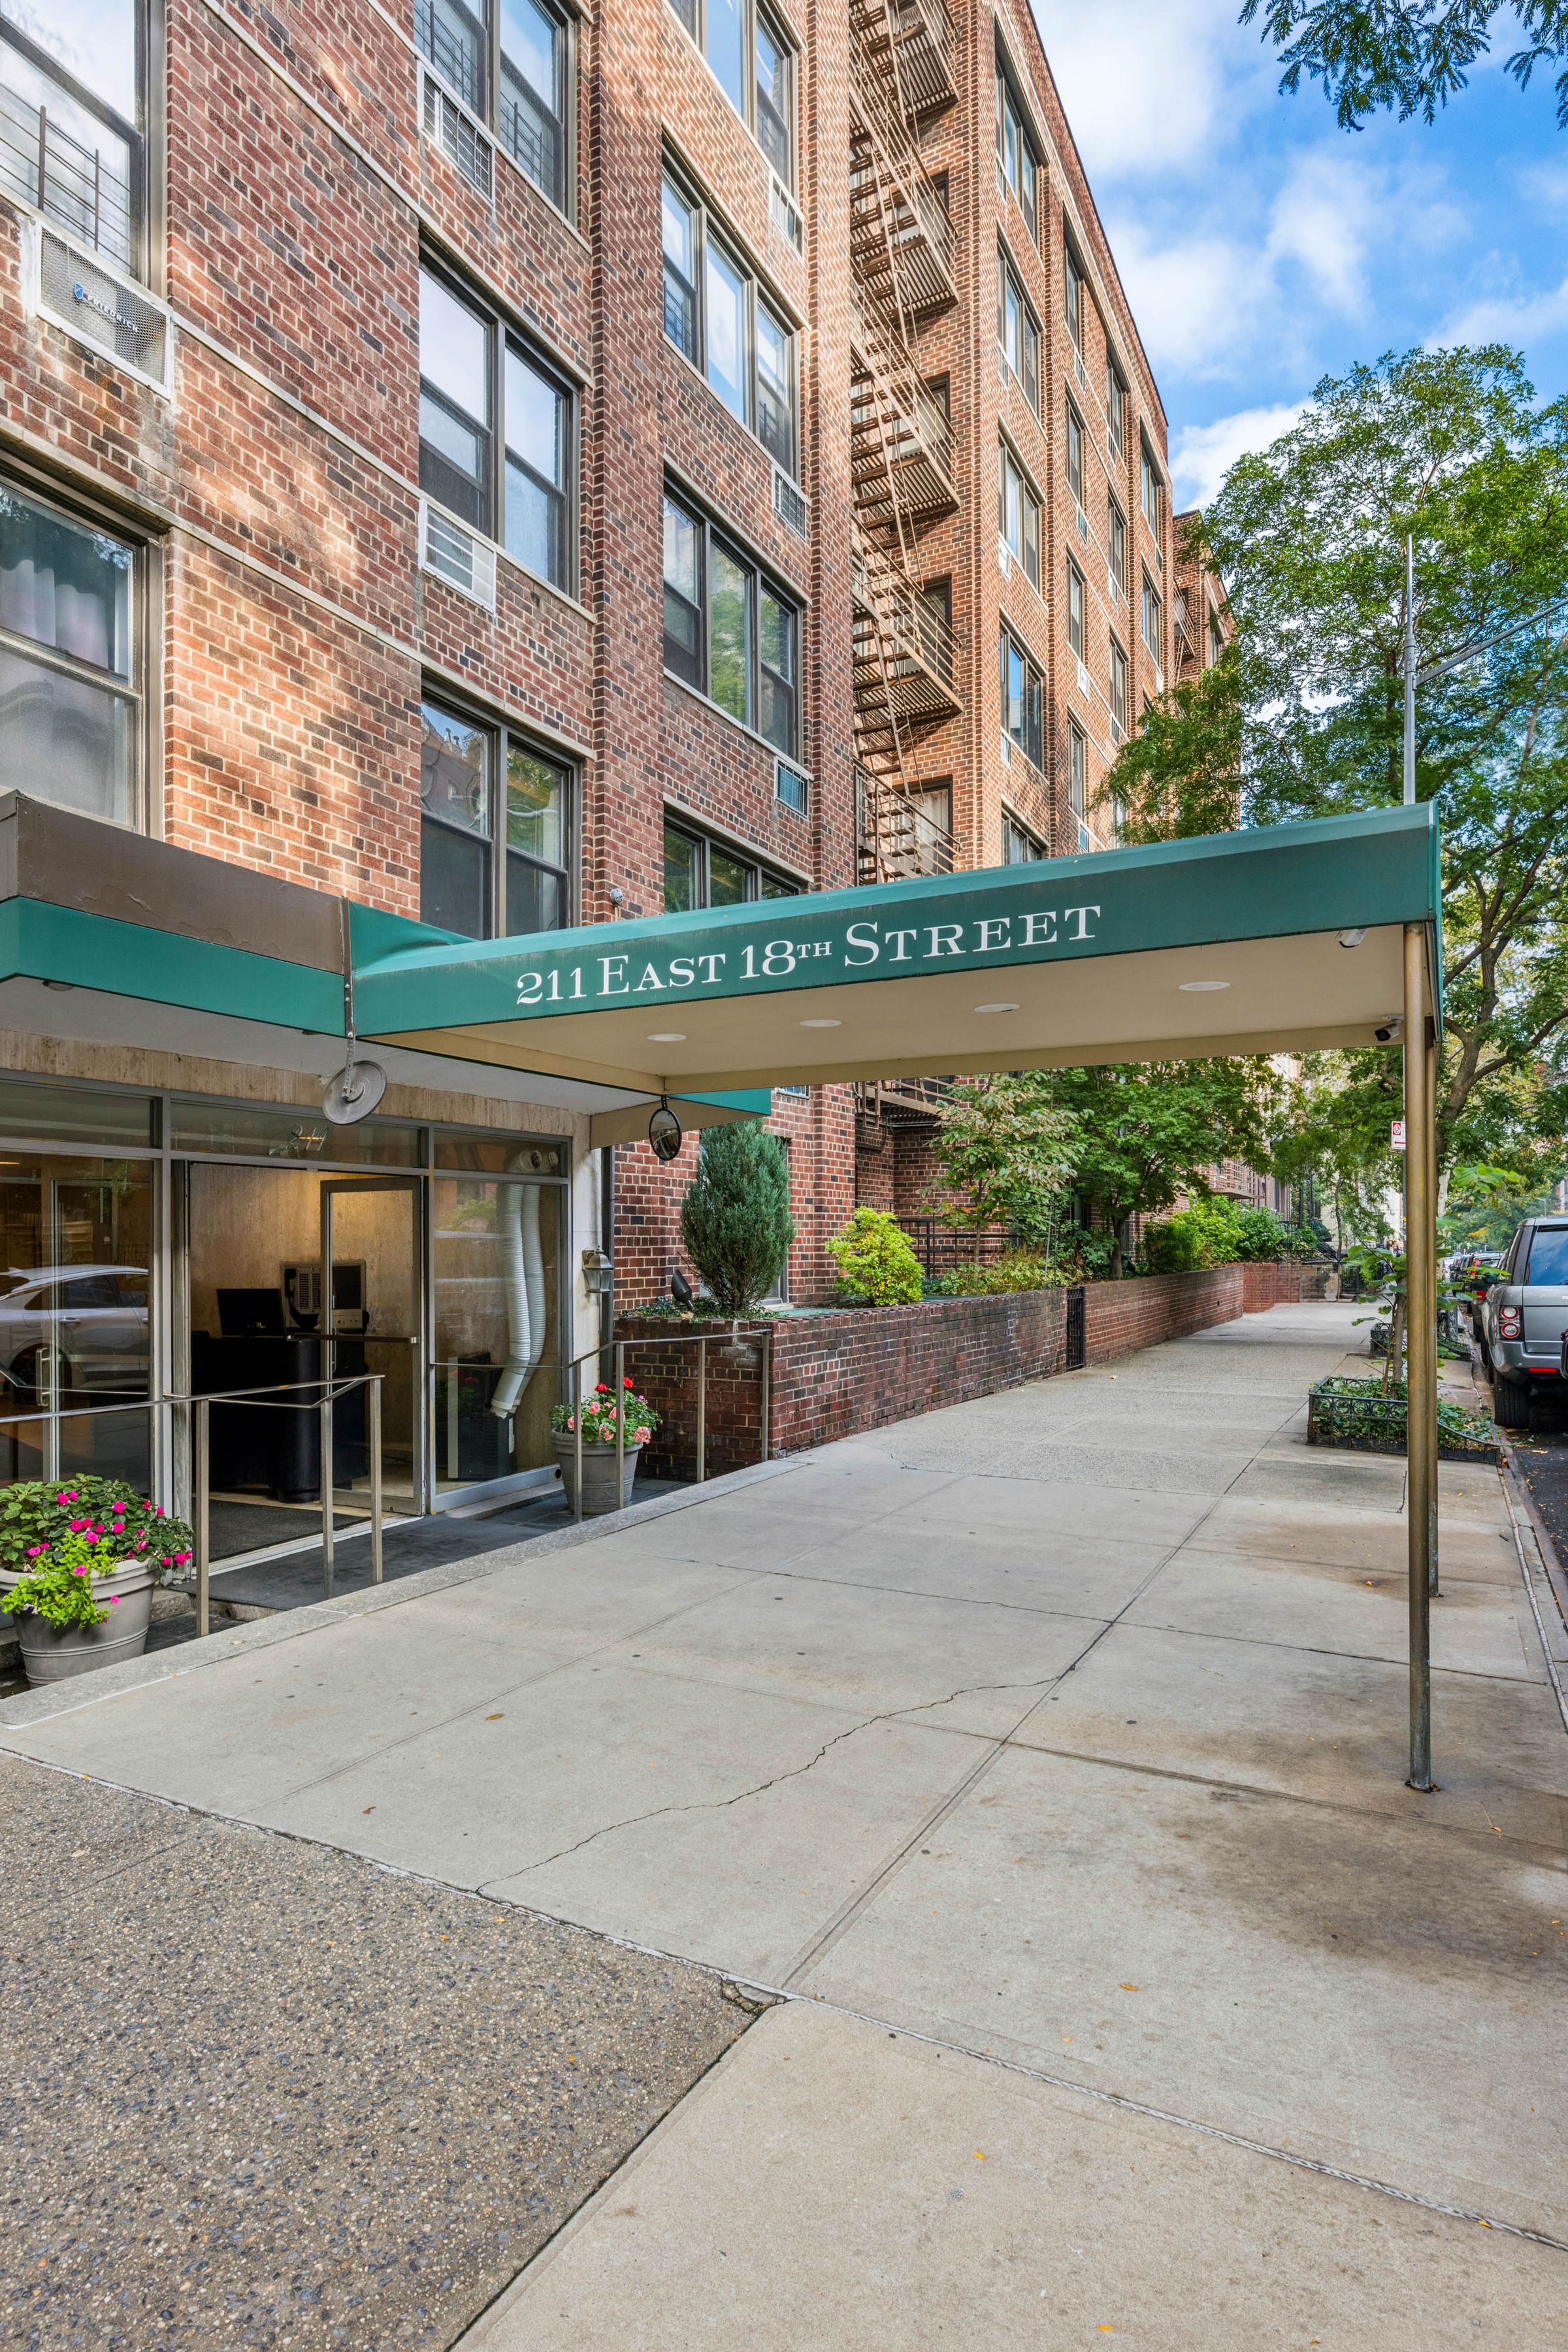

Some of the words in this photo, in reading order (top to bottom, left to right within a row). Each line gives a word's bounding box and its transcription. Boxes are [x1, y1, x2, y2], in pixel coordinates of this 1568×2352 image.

[88, 293, 138, 333] FRIEDRICH
[517, 967, 587, 1005] 211
[596, 953, 727, 996] EAST
[844, 906, 1100, 966] STREET
